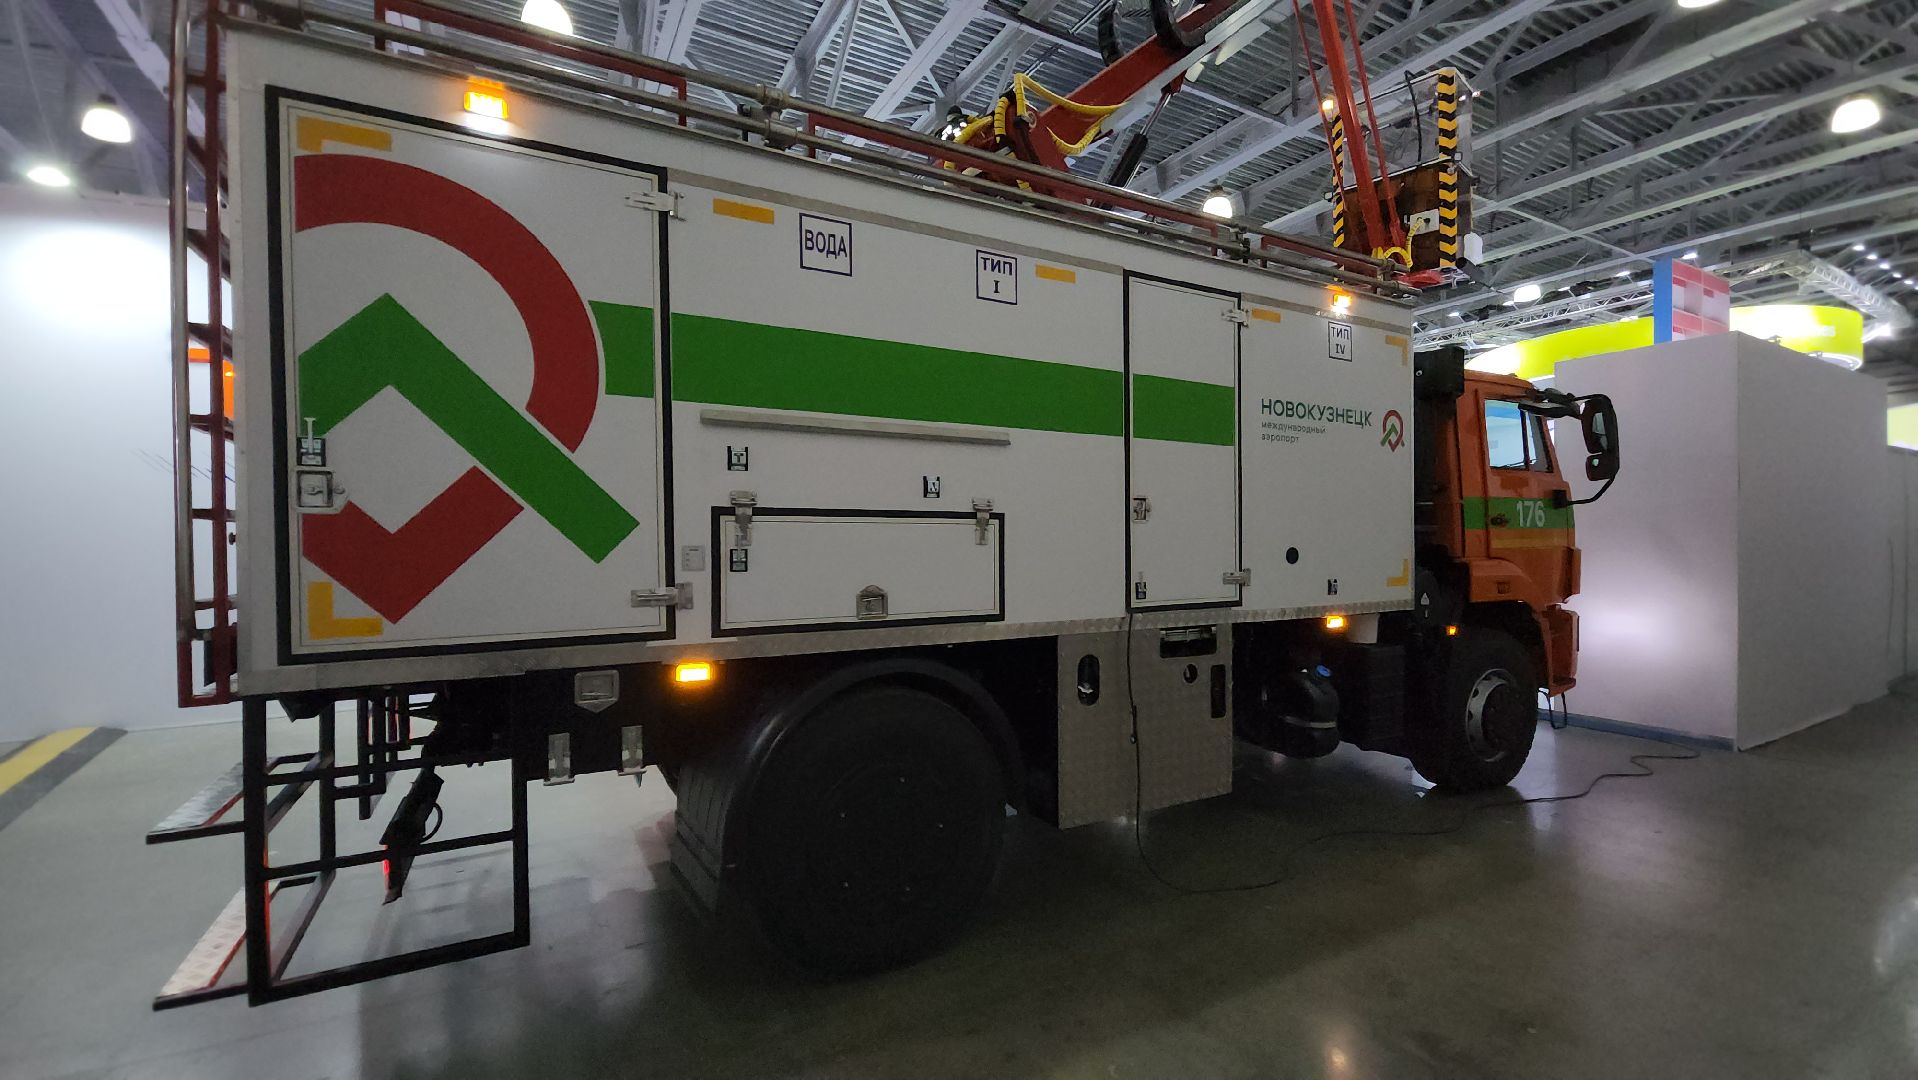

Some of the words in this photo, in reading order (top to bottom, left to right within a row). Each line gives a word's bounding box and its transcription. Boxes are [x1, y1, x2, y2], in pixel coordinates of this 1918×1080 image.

[804, 228, 848, 260] ВОДА
[980, 256, 1012, 276] ТИП
[993, 279, 1000, 293] I
[1331, 326, 1349, 340] ТИП
[1335, 343, 1346, 355] IV
[1261, 398, 1373, 430] НОВОКУЗНЕЦК
[1261, 421, 1326, 435] международный
[1261, 433, 1300, 444] аэропорт
[1517, 501, 1545, 527] 176
